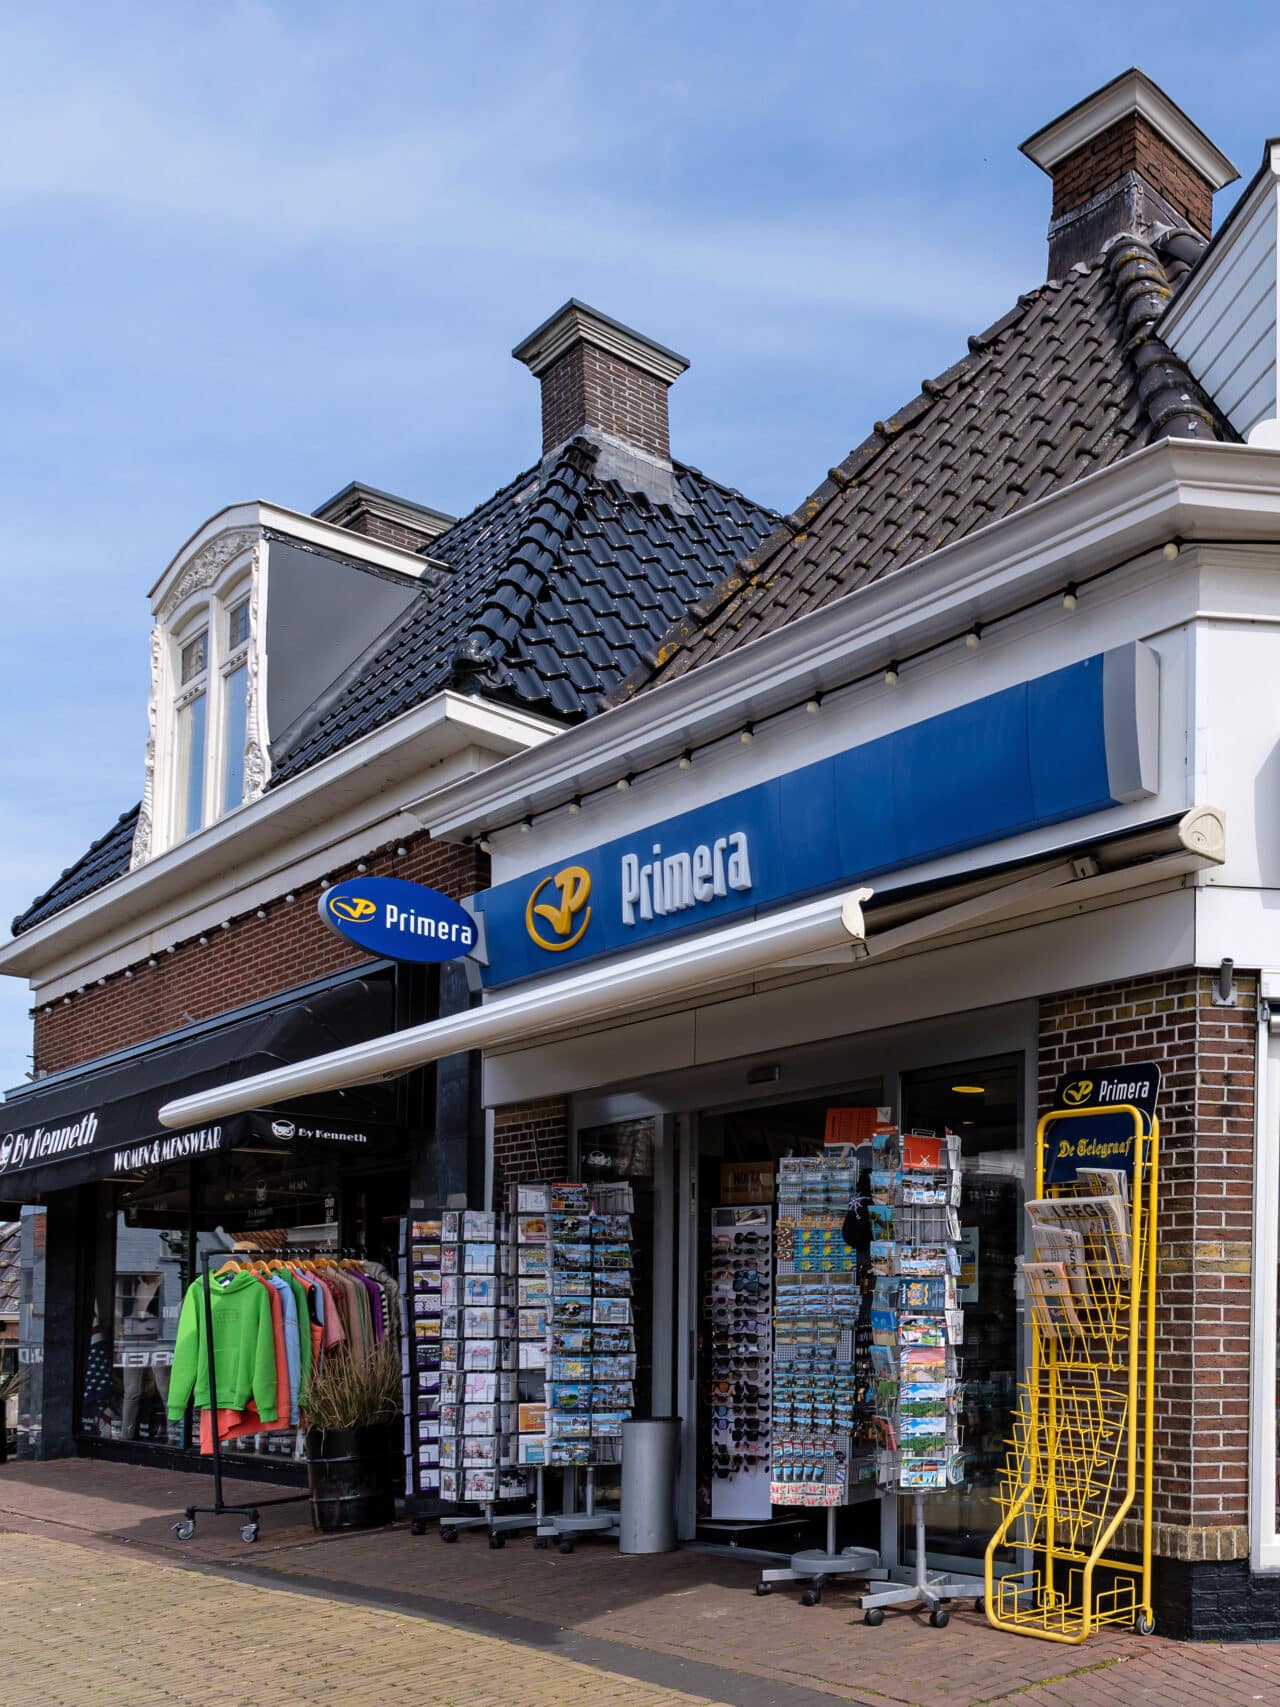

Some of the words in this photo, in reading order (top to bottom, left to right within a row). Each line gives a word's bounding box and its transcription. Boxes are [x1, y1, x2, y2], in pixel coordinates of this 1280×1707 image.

[621, 831, 752, 926] Primera
[386, 903, 472, 945] Primera
[1098, 1079, 1150, 1103] Primera
[10, 1133, 33, 1168] By
[29, 1112, 100, 1160] Kenneth
[113, 1145, 151, 1172] WOMEN
[150, 1140, 160, 1165] &
[160, 1126, 222, 1163] MENSWEAR
[298, 1128, 314, 1140] By
[315, 1129, 368, 1143] Kenneth
[1057, 1140, 1076, 1158] De
[1077, 1136, 1134, 1158] Telegraaf
